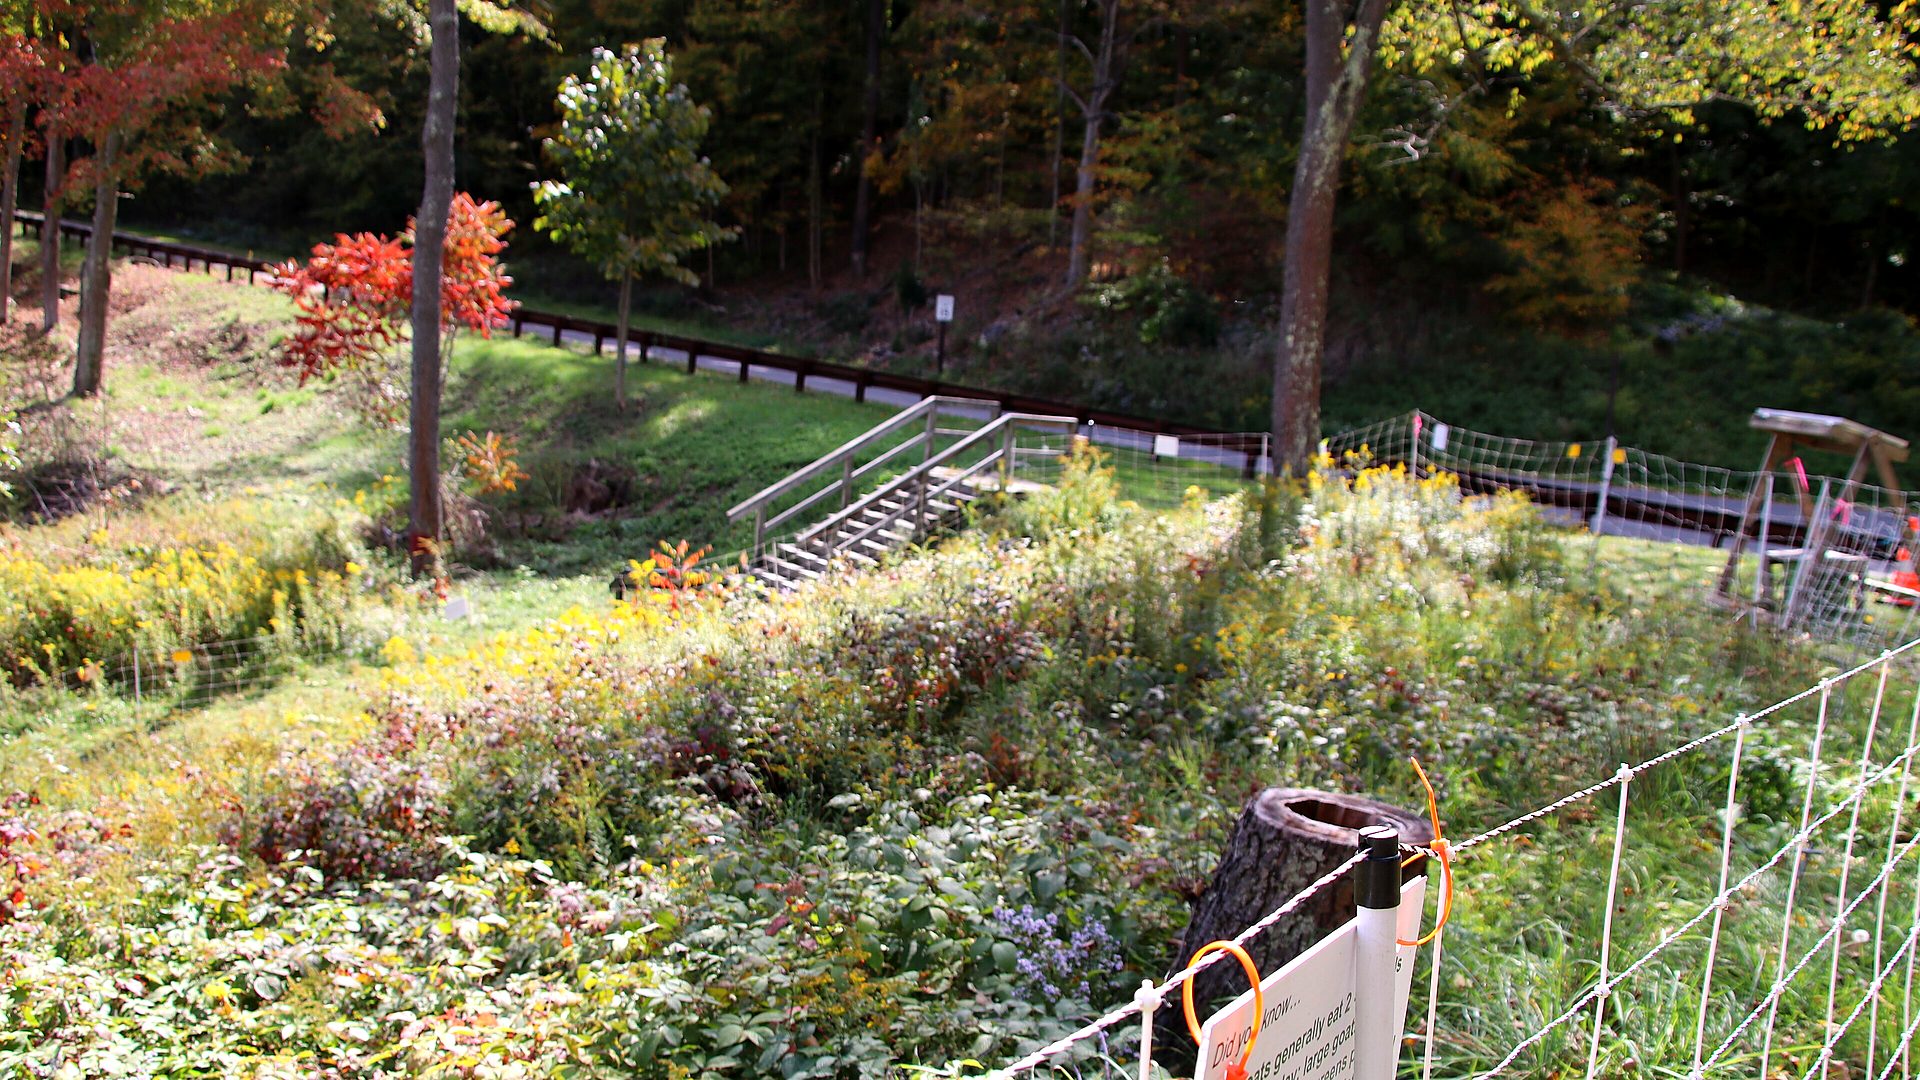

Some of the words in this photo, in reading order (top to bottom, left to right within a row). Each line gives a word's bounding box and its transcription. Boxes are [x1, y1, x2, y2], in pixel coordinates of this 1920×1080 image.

[1212, 1032, 1236, 1069] Did
[1235, 1026, 1253, 1057] yo
[1273, 1017, 1326, 1075] generally
[1327, 999, 1344, 1027] eat
[1303, 1043, 1330, 1076] large
[1332, 1019, 1355, 1056] goat
